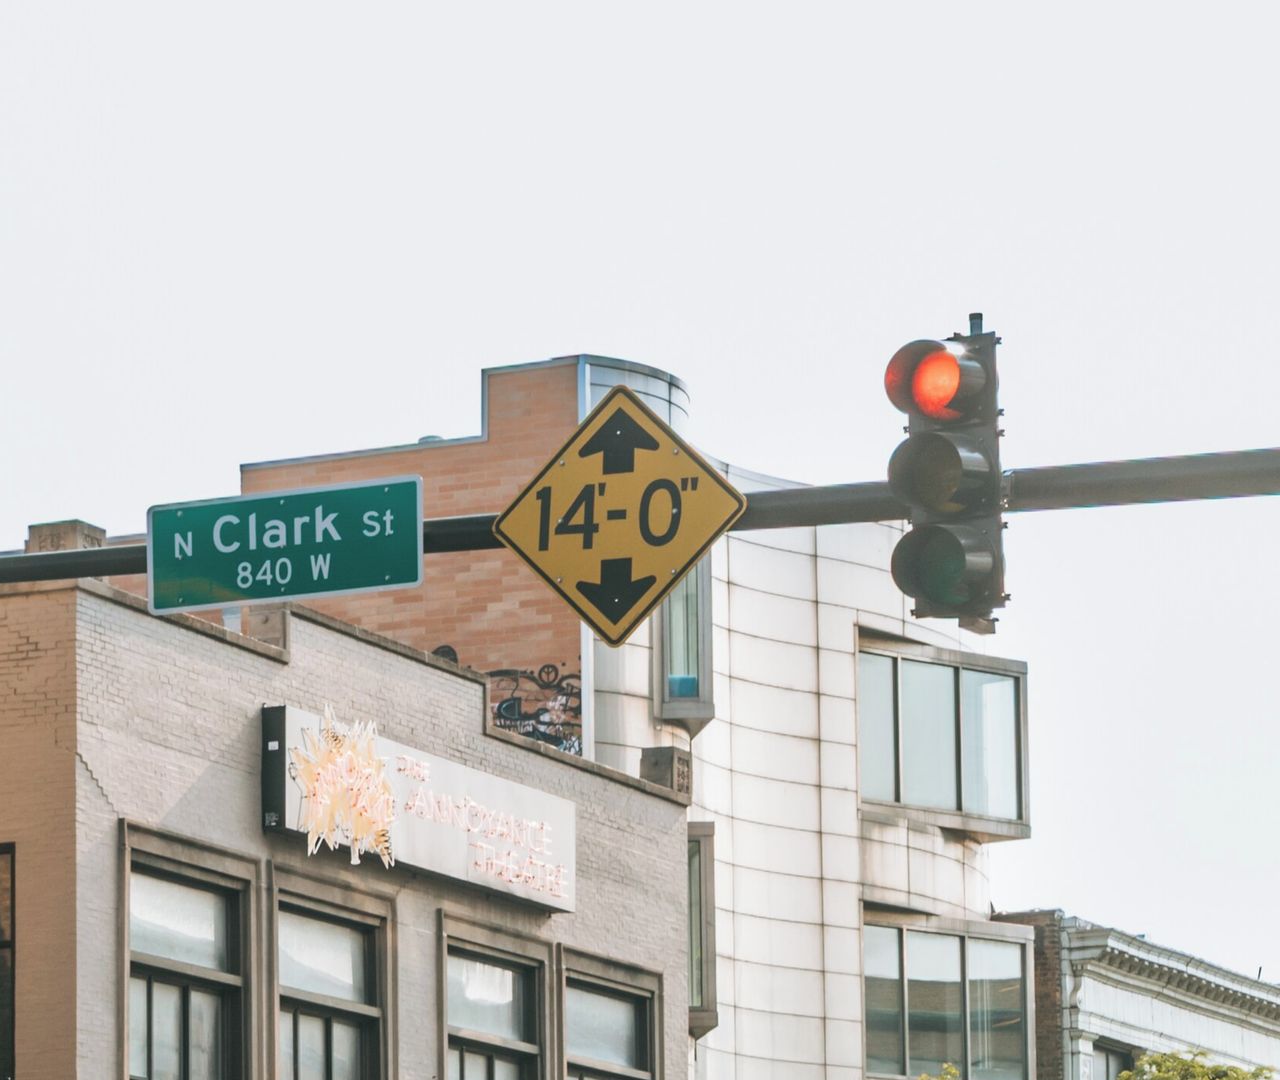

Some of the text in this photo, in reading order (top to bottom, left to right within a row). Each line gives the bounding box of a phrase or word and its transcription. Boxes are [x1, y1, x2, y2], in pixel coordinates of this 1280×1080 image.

[174, 505, 394, 559] N Clark St
[237, 553, 331, 589] 840 W
[404, 788, 553, 856] ANNOYANCE
[470, 842, 569, 898] THEATRE
